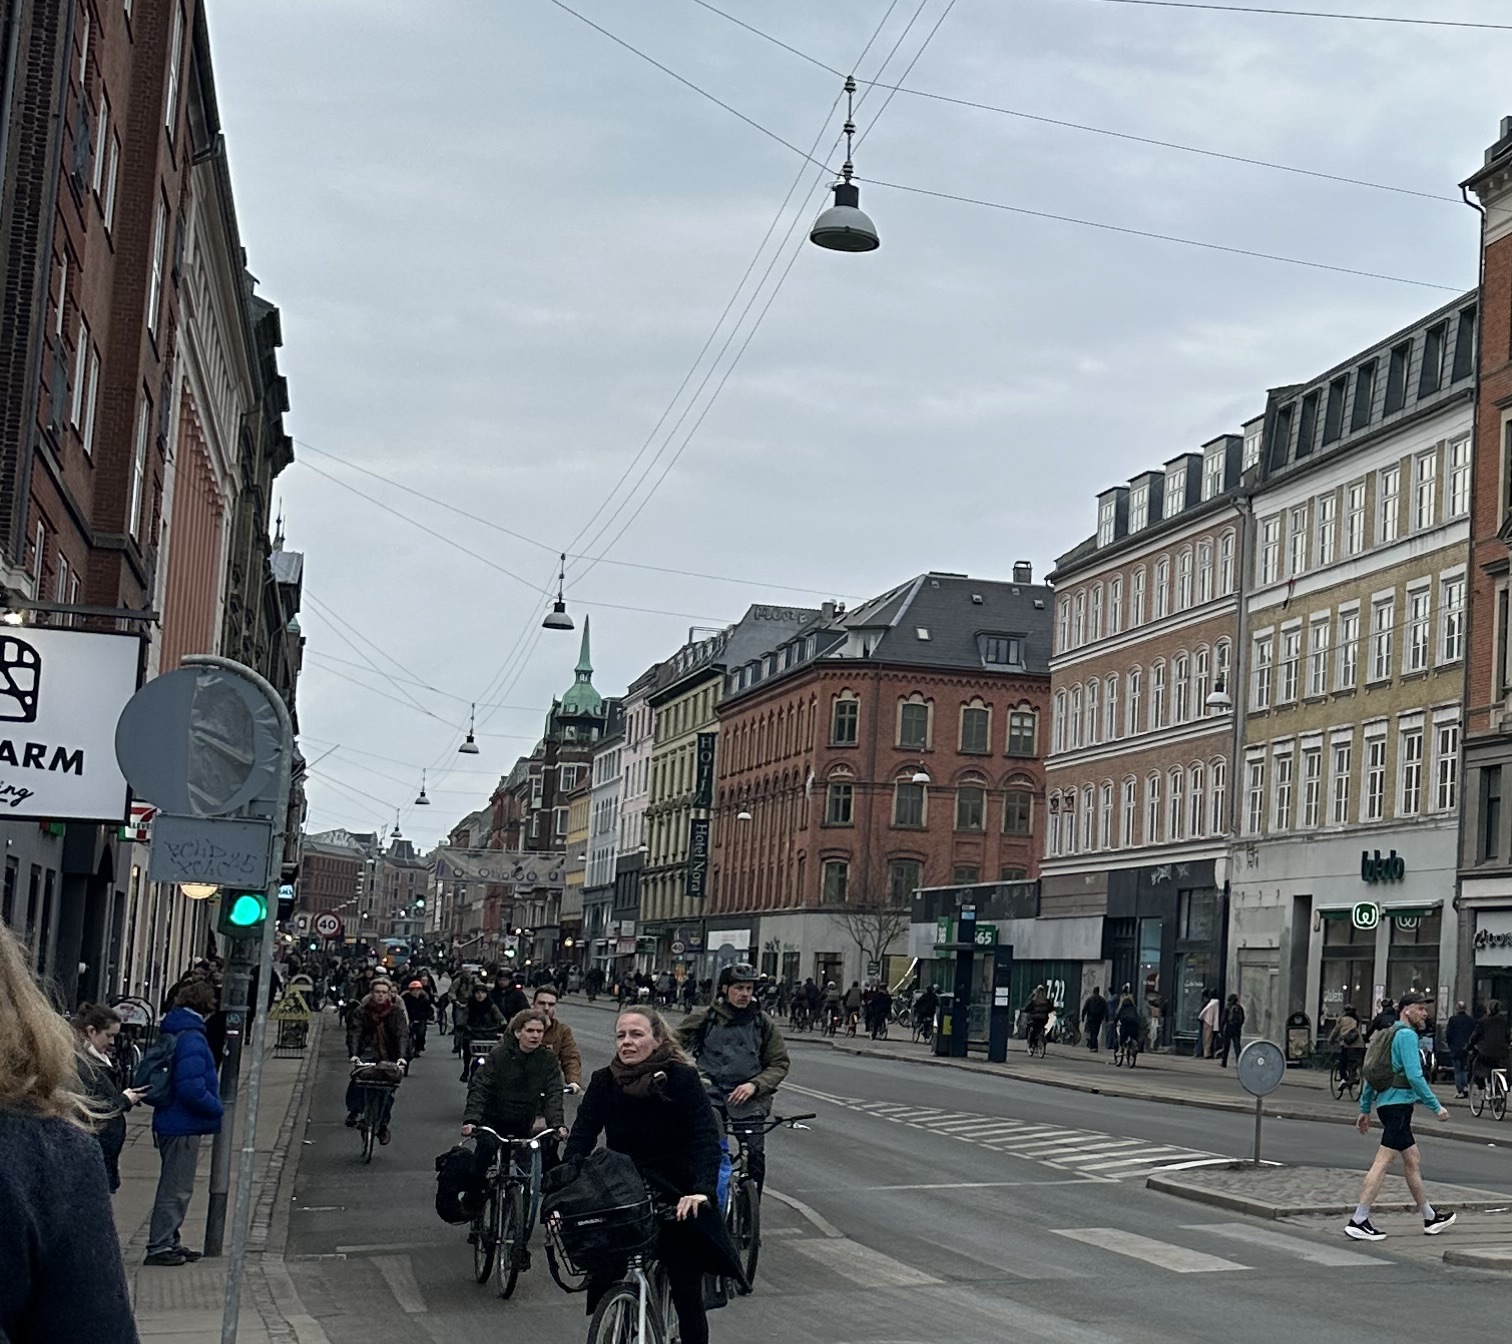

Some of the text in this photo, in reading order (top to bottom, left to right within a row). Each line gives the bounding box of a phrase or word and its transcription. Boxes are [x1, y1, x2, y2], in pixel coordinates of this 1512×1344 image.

[0, 740, 84, 776] ARM
[691, 823, 708, 893] Hotel Nora
[320, 920, 336, 930] 40
[672, 943, 684, 953] 40
